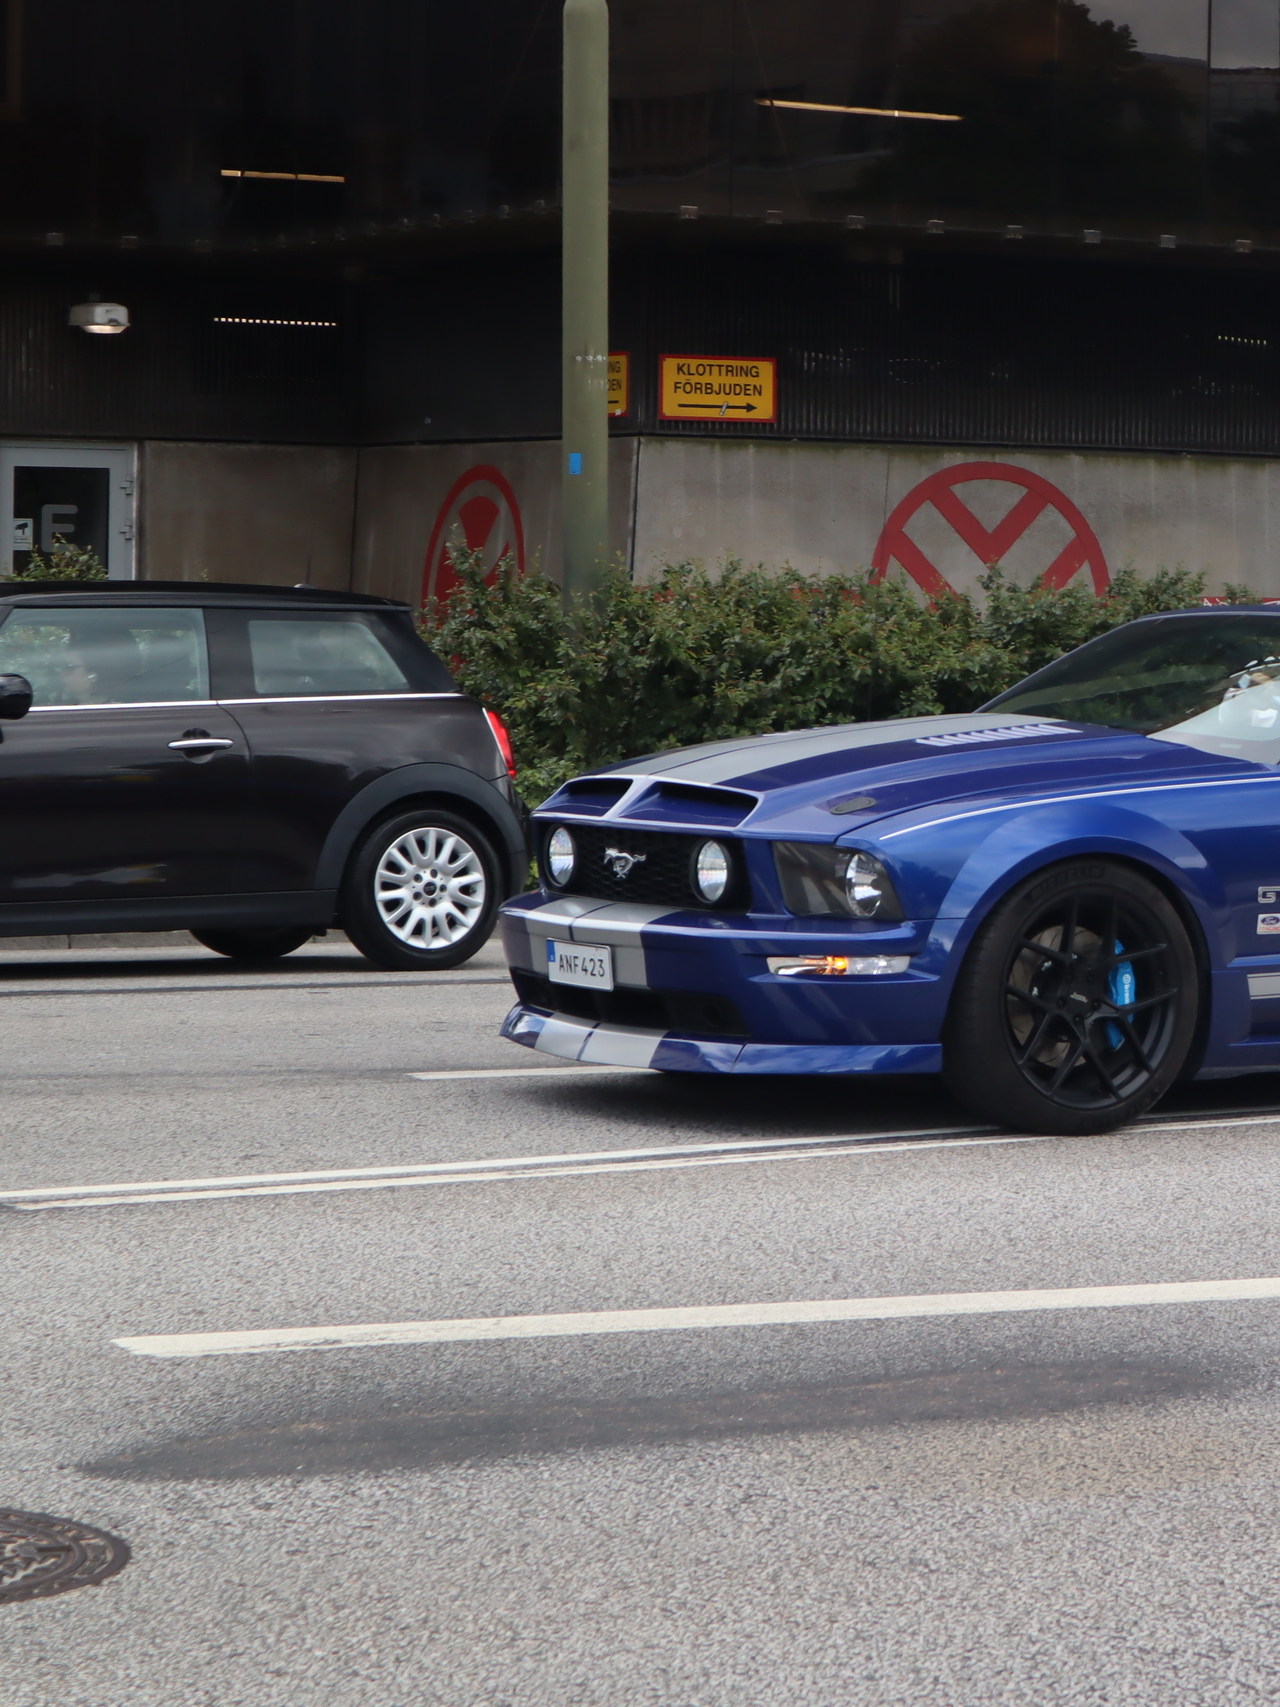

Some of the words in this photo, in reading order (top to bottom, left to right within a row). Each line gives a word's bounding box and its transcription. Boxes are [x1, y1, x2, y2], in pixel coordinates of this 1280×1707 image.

[676, 363, 760, 378] KLOTTRING
[673, 379, 763, 397] FÖRBJUDEN
[41, 504, 79, 553] E
[558, 953, 579, 974] ANF
[581, 956, 606, 978] 423
